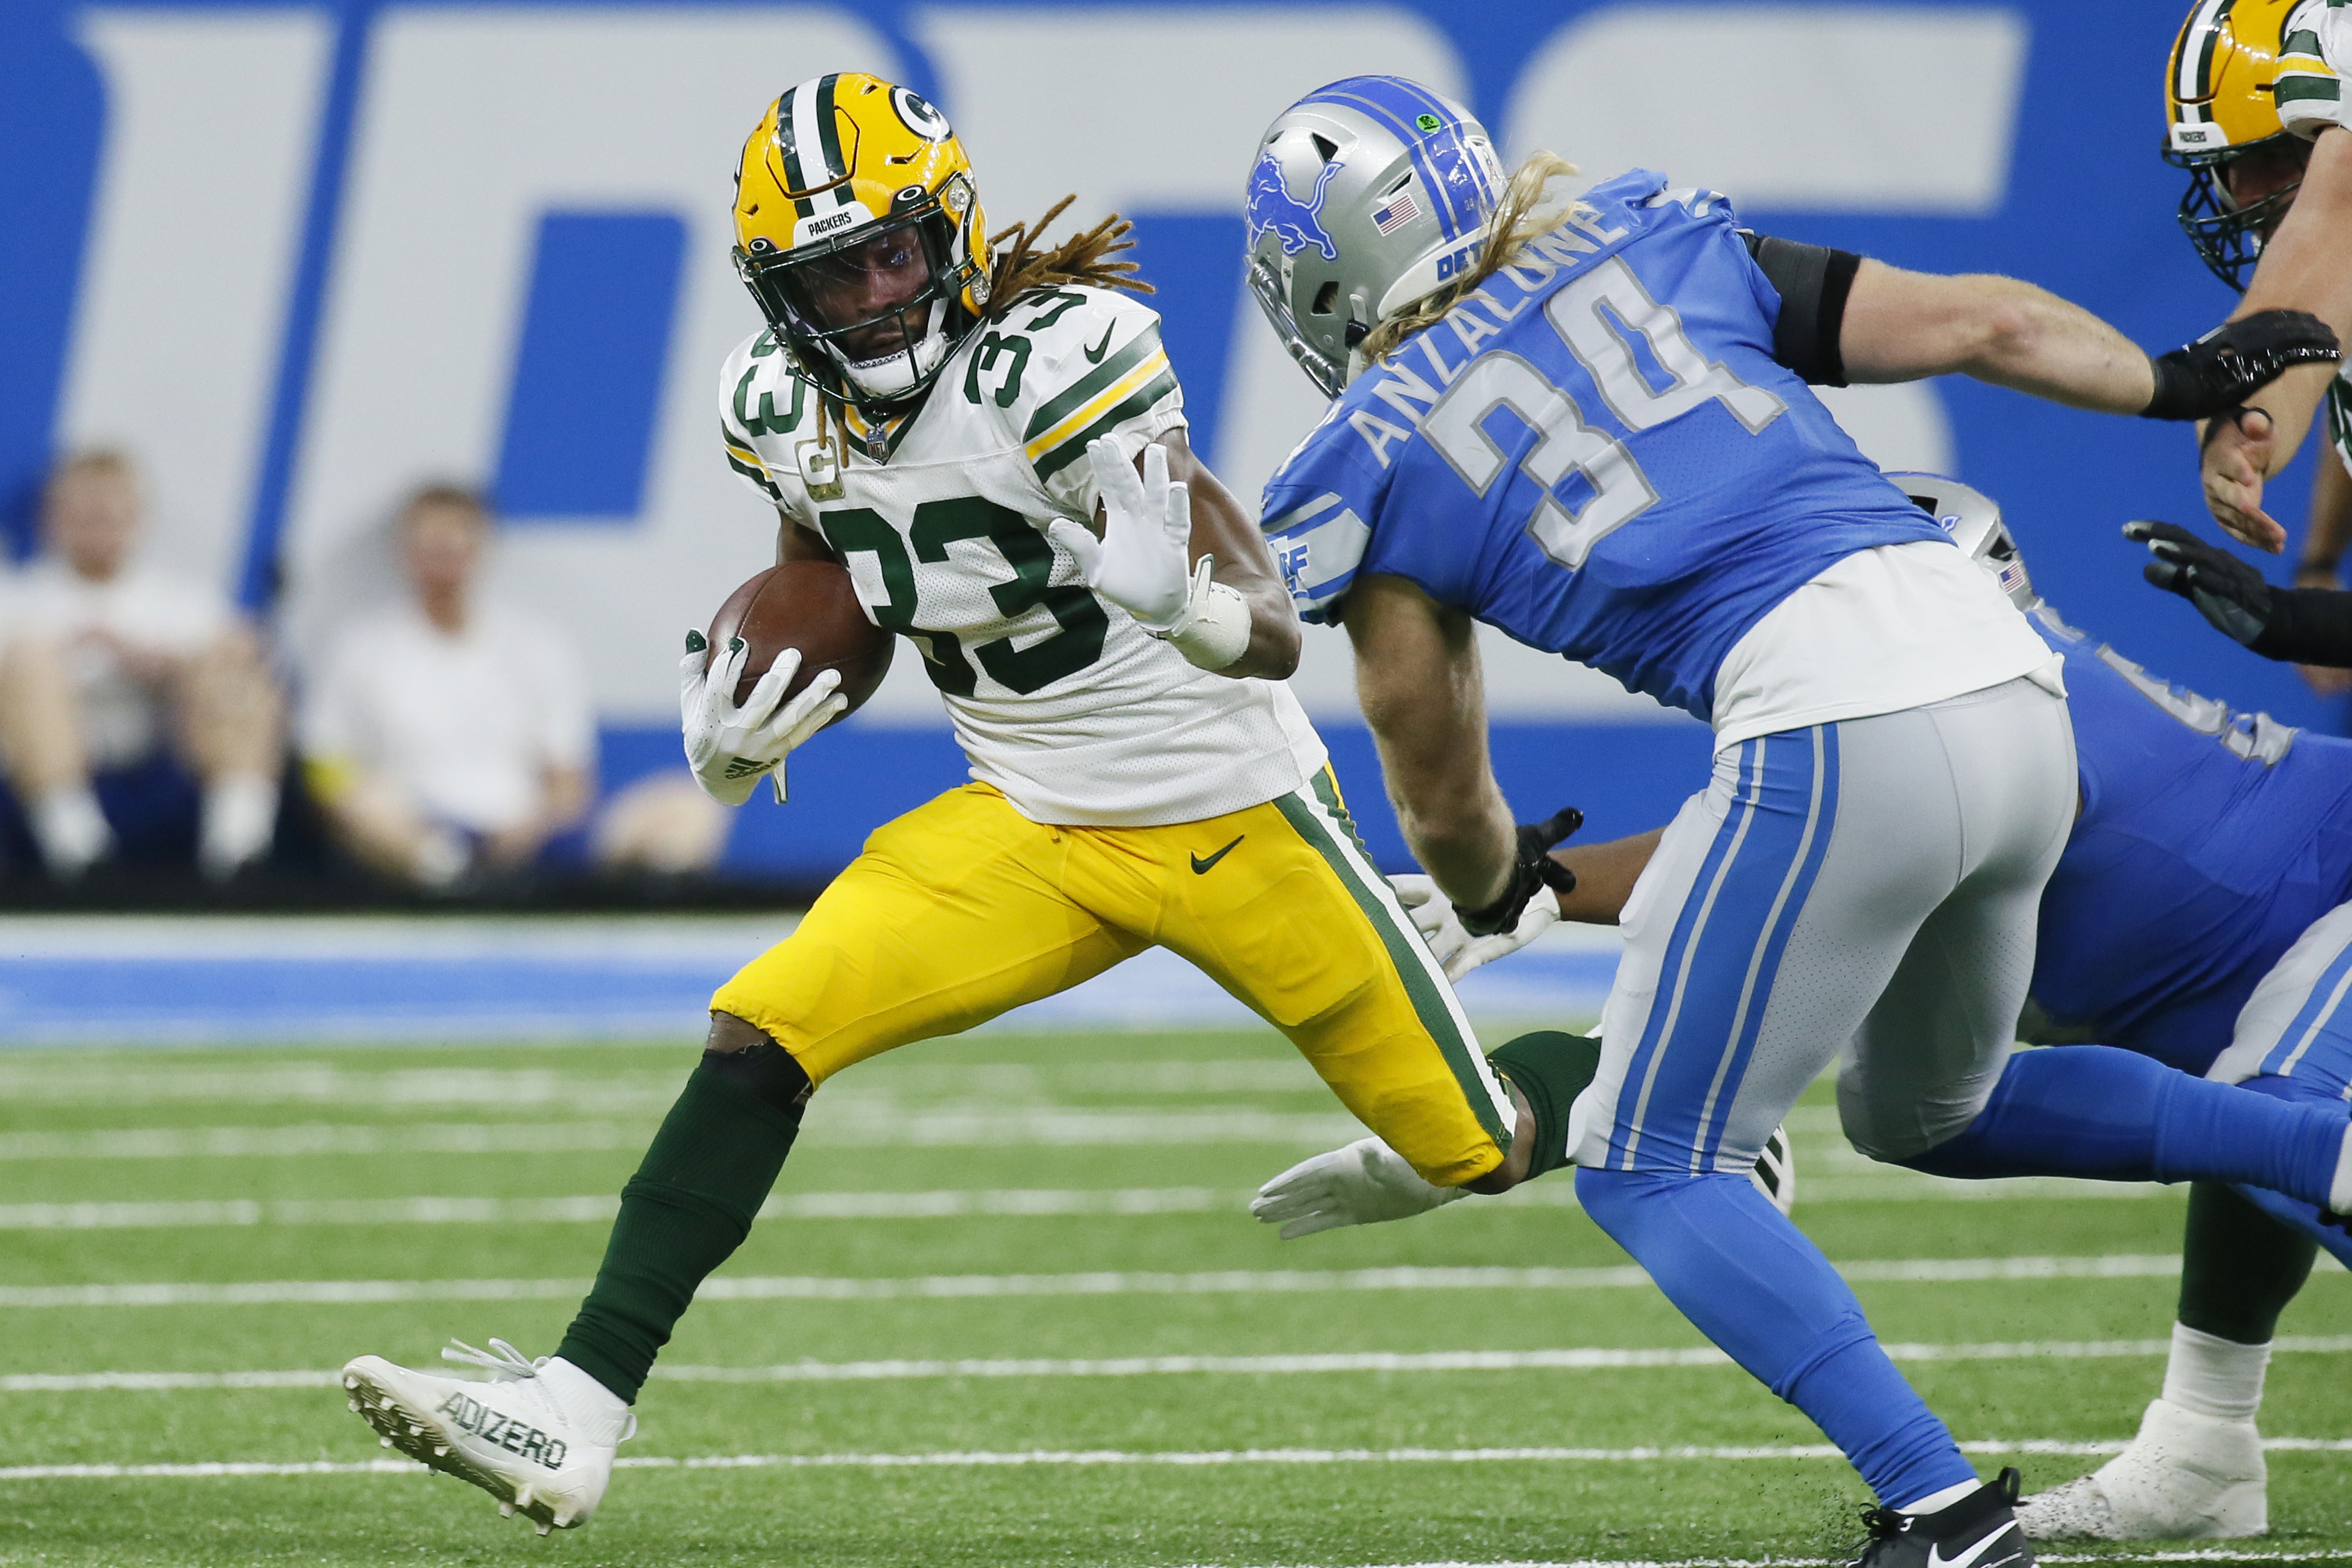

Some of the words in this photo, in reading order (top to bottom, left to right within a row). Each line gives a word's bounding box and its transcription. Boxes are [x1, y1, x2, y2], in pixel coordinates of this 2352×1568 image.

[807, 211, 852, 237] PACKERS
[964, 289, 1087, 408] 33
[1348, 207, 1629, 470] ANZALONE
[798, 441, 836, 487] C
[1416, 256, 1788, 573] 34
[819, 496, 1110, 697] 33
[435, 1392, 567, 1470] ADIZERO
